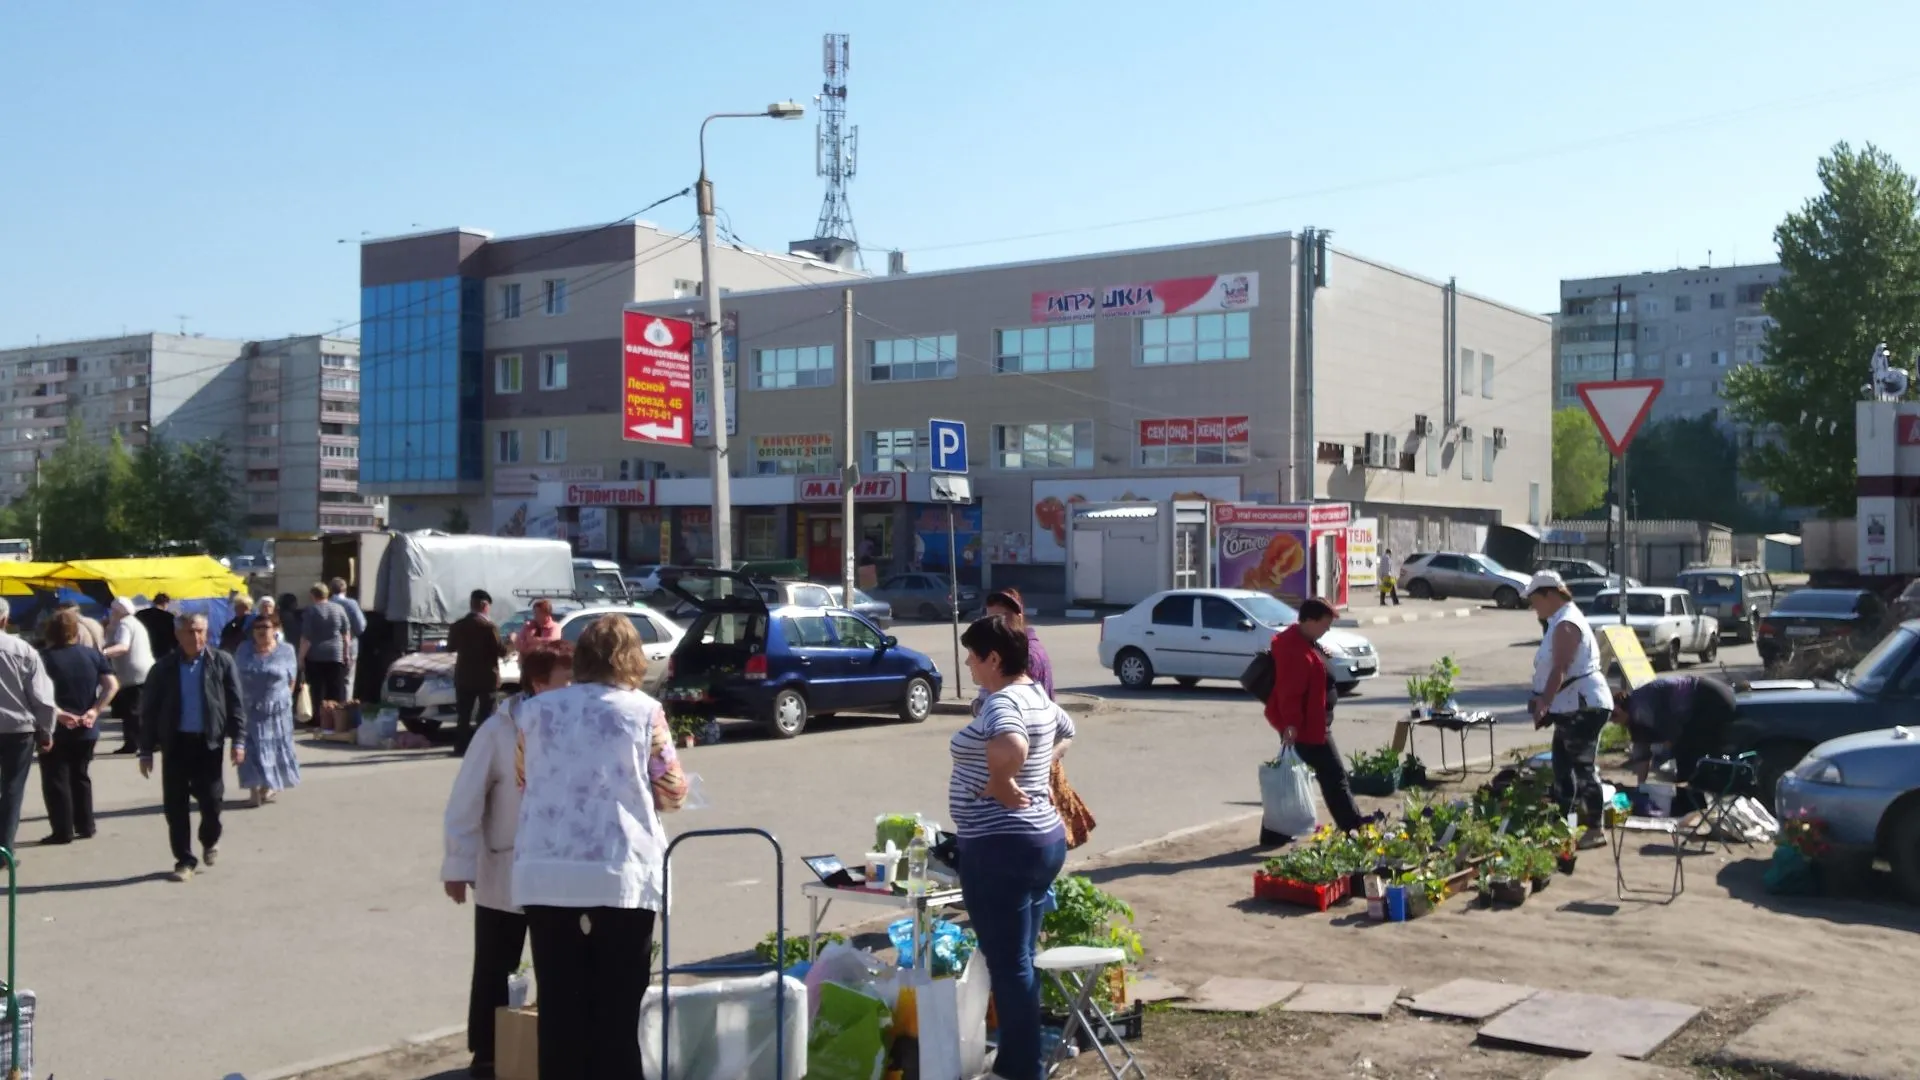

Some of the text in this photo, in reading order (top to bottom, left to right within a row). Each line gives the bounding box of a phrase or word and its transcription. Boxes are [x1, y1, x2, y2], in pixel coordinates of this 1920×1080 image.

[1047, 287, 1154, 312] ИГРУШКИ
[627, 377, 666, 393] Лесной
[805, 481, 891, 497] МАНИТ
